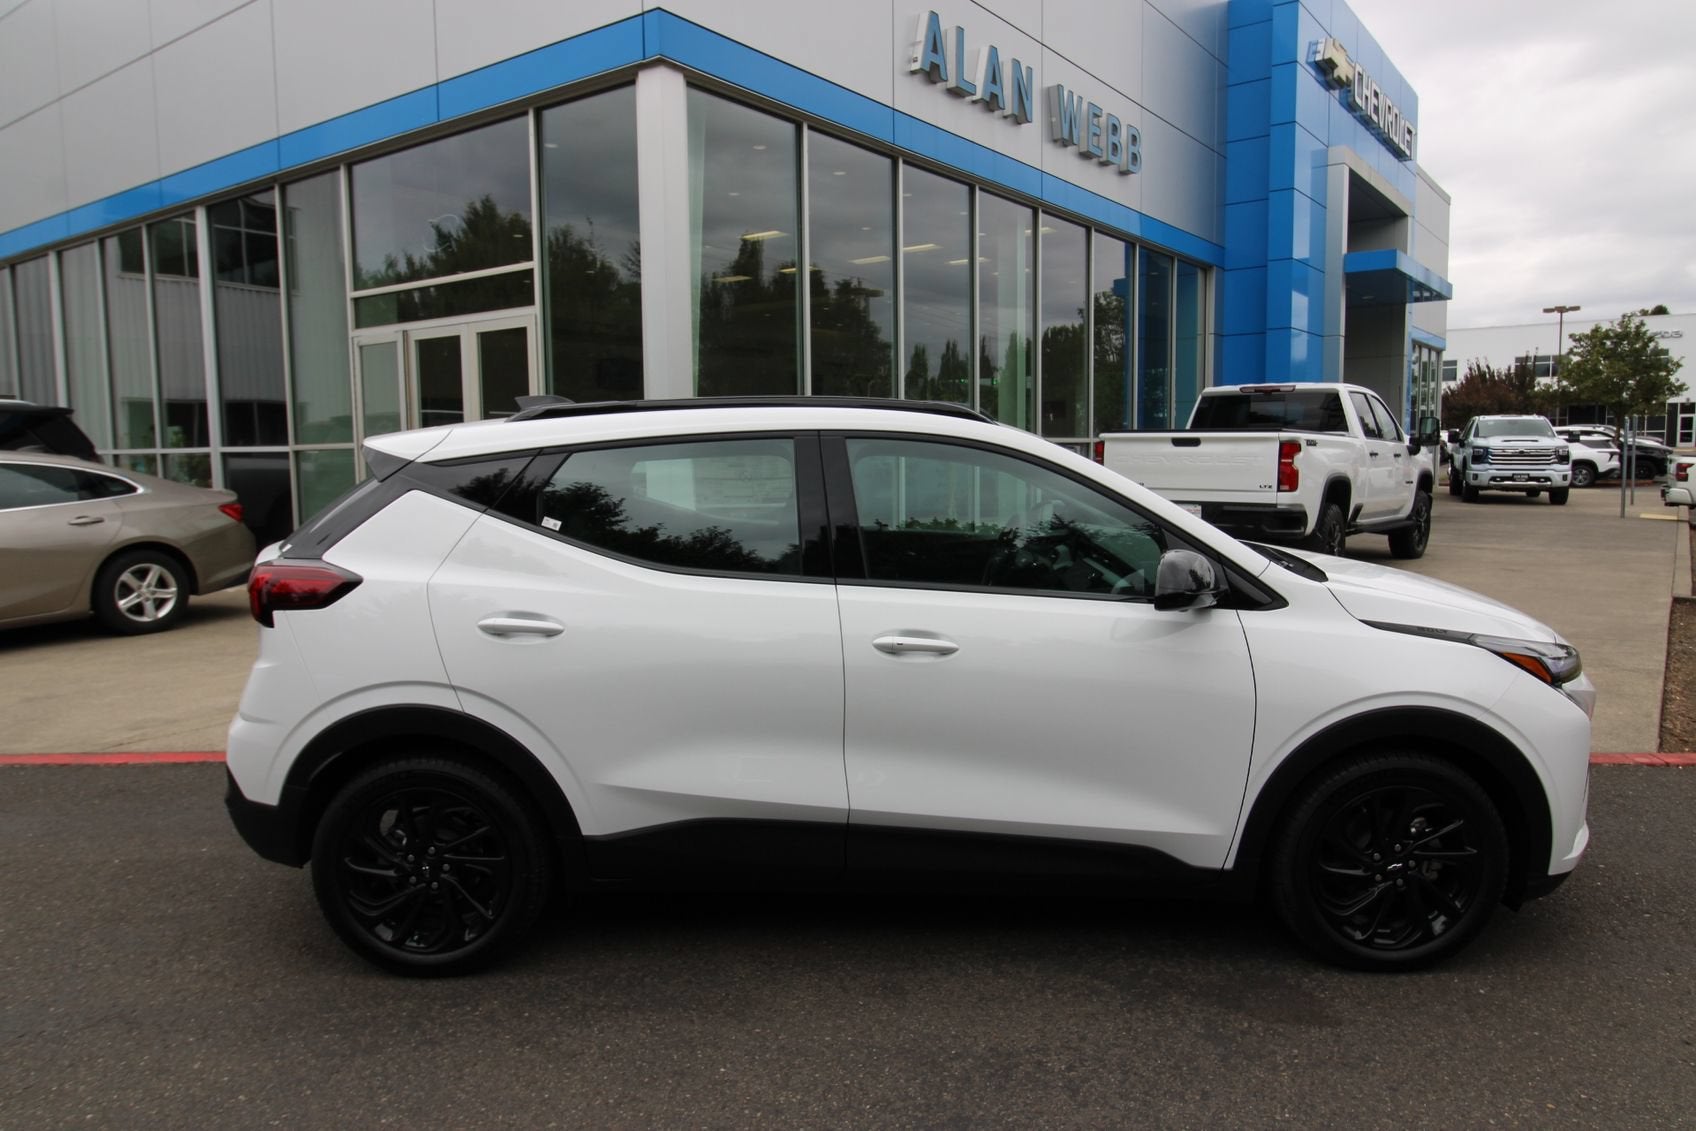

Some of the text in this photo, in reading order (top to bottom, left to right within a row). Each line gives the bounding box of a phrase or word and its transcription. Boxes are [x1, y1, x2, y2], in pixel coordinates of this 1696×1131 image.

[911, 10, 1142, 175] ALAN WEBB
[1353, 62, 1417, 161] CHEVROLET
